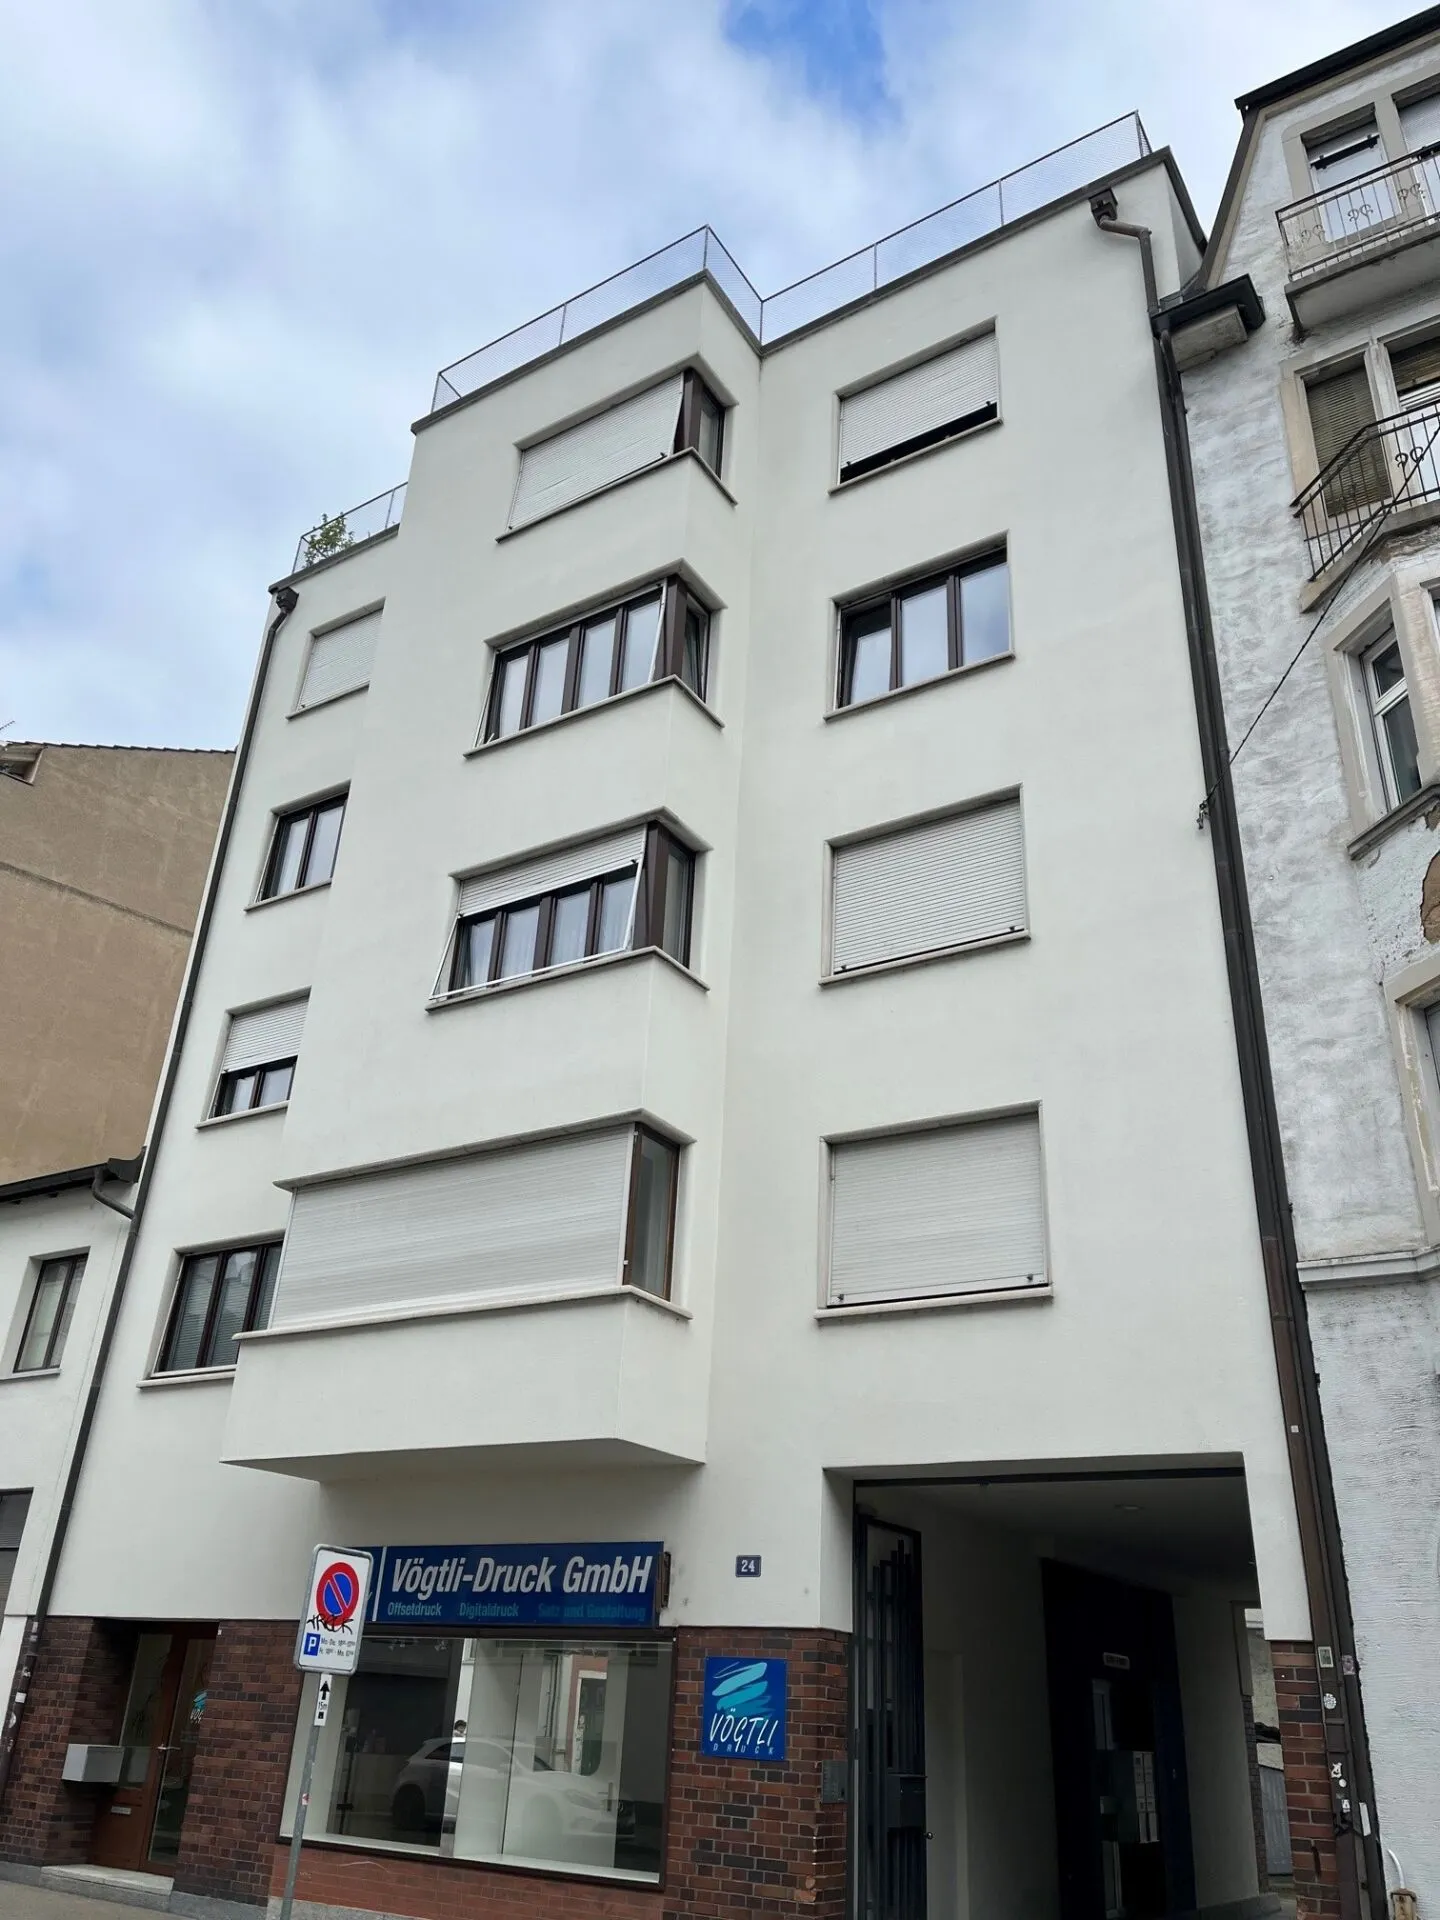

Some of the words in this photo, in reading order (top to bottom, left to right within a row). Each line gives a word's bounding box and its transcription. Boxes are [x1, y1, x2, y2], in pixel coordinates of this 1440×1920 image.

[741, 1560, 755, 1572] 24
[392, 1557, 556, 1600] Vögtli-Druck
[563, 1556, 653, 1593] GmbH
[388, 1602, 441, 1616] Offsetdruck
[459, 1602, 519, 1619] Digitaldruck
[564, 1604, 584, 1617] und
[308, 1636, 317, 1652] P
[710, 1708, 778, 1752] VÖGTLI
[713, 1743, 774, 1755] DRUCK
